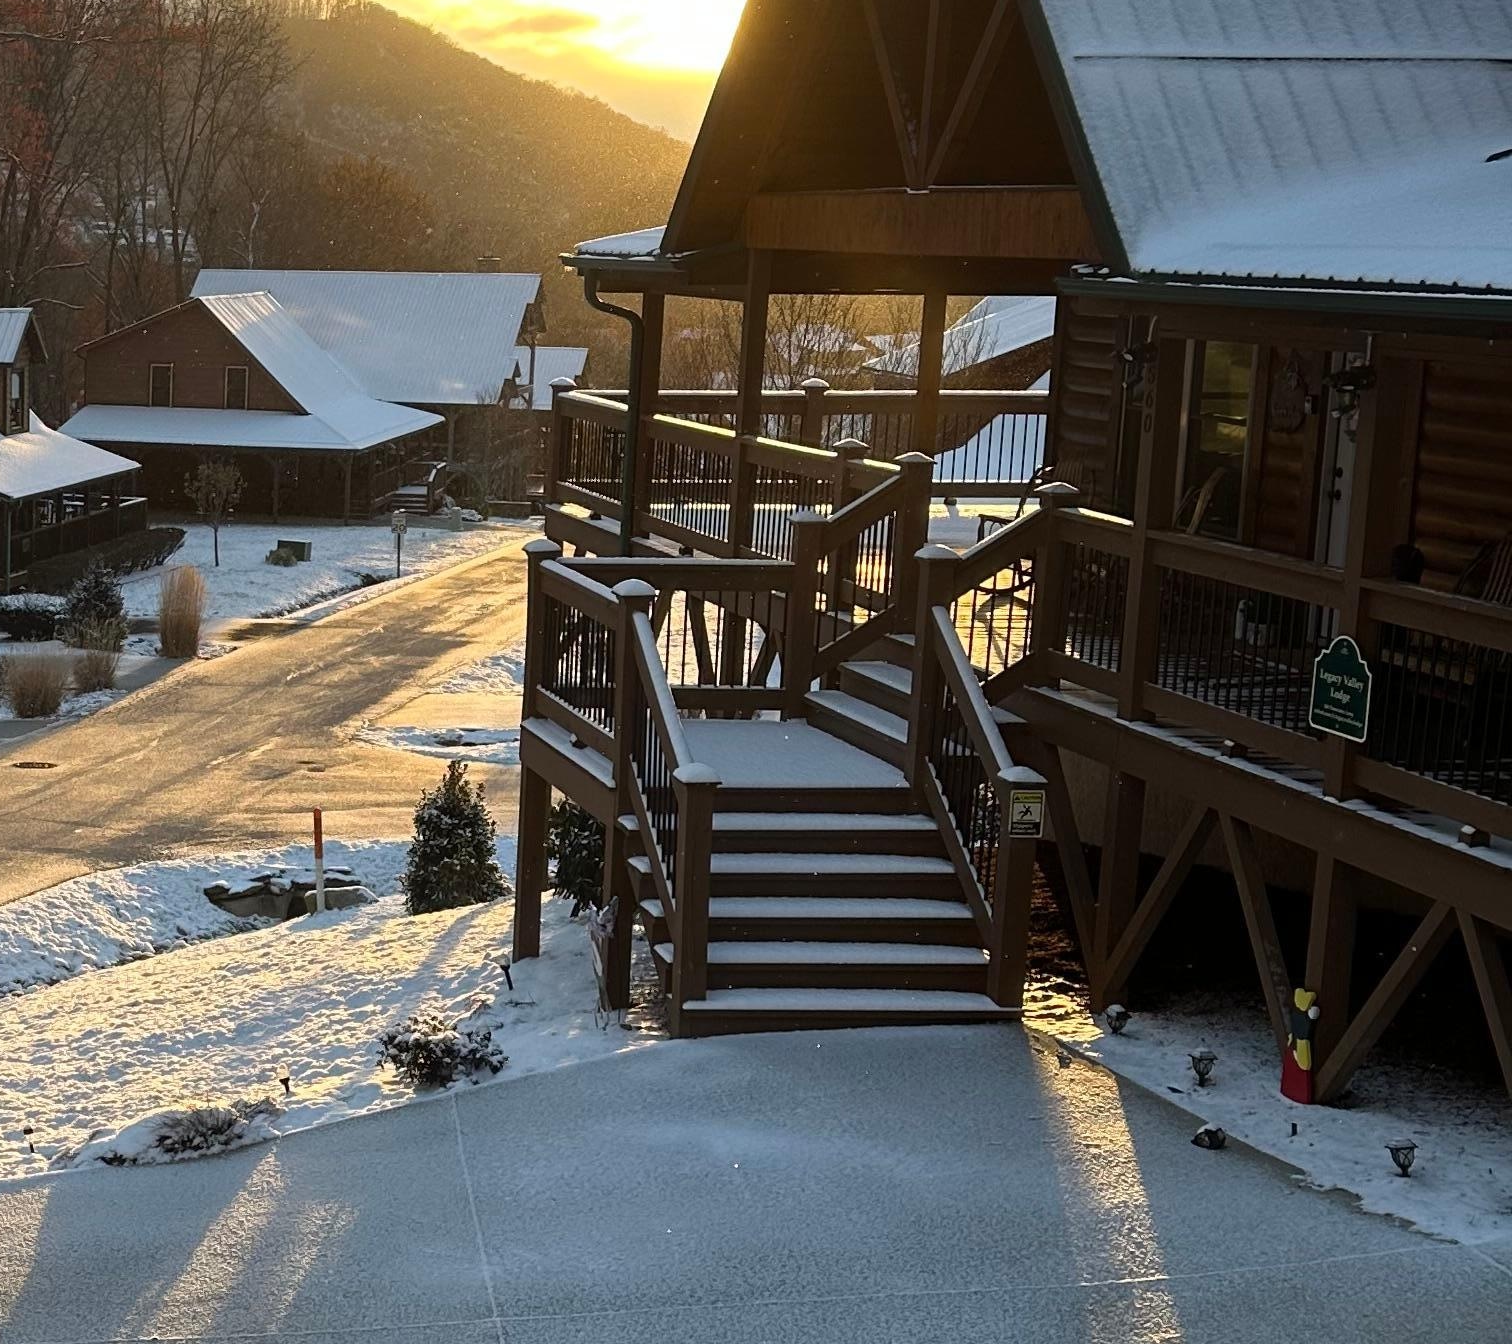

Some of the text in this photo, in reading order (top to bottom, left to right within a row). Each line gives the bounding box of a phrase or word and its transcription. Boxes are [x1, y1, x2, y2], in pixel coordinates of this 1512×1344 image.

[1319, 667, 1365, 694] Legacy Valley
[1330, 687, 1351, 704] Lodge
